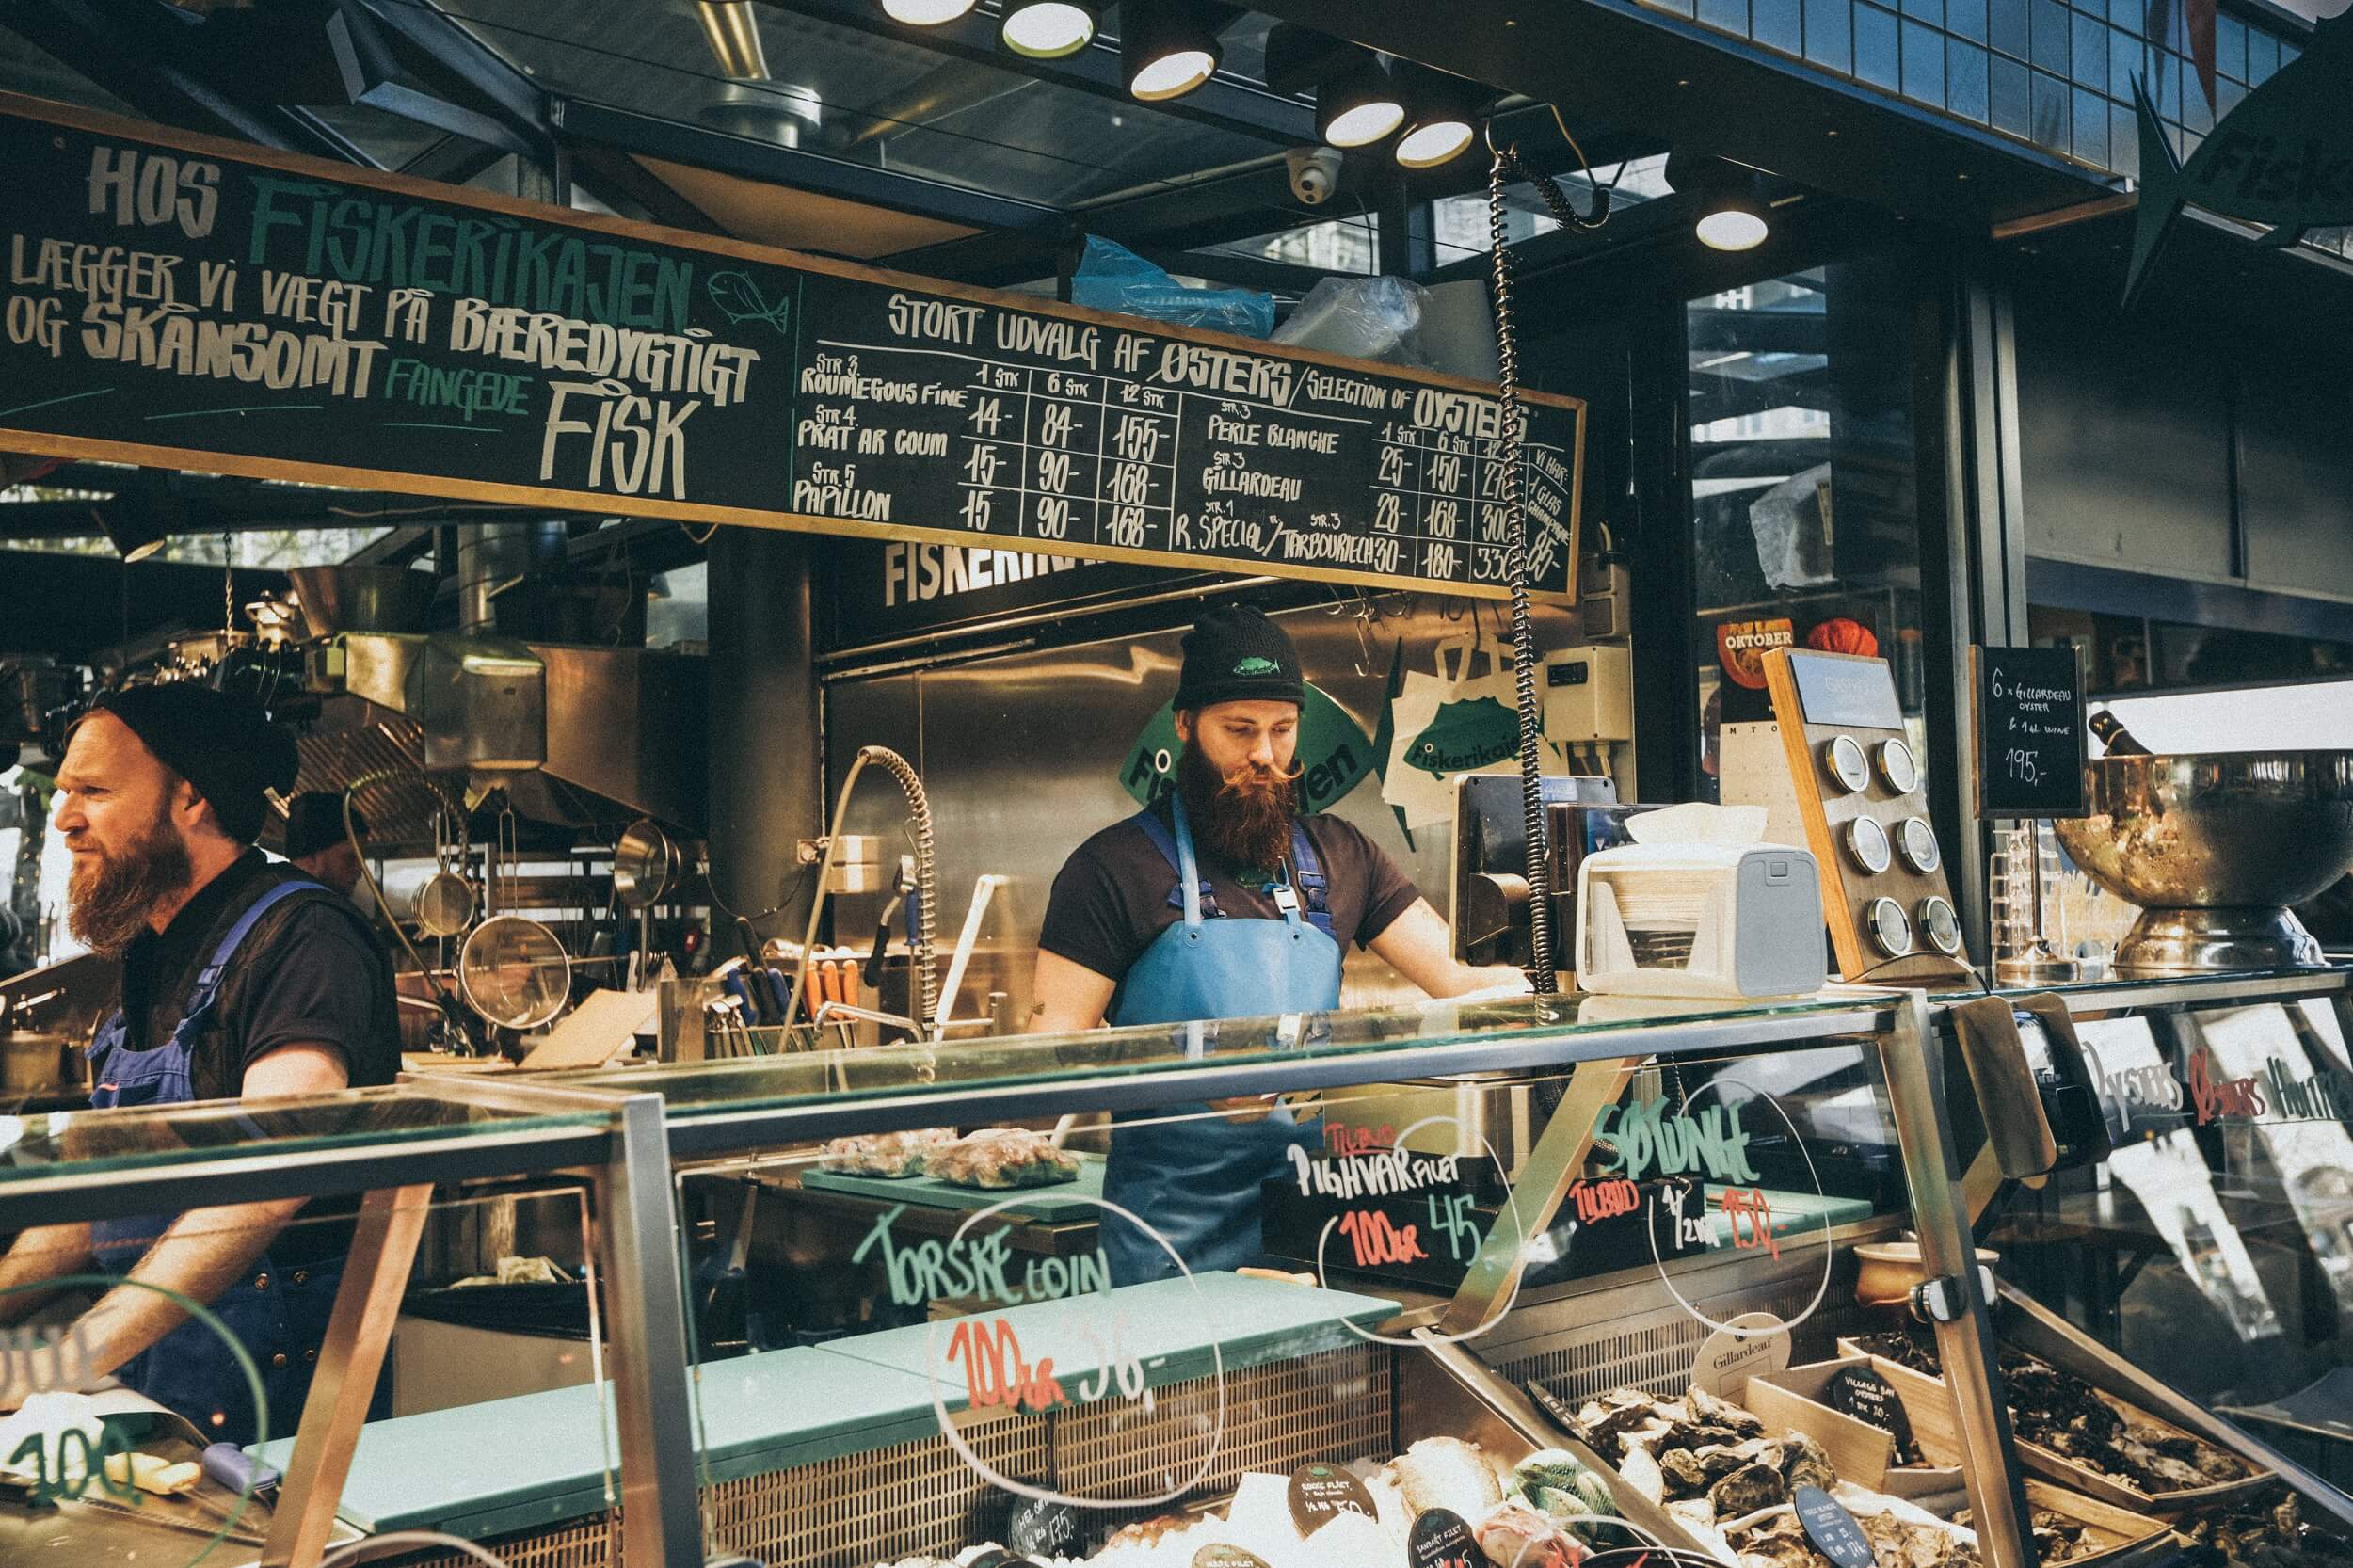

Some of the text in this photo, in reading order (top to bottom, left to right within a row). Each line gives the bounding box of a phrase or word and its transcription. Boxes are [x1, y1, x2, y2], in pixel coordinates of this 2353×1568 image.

[86, 146, 220, 239] HOS
[11, 233, 184, 304] LÆGGER
[262, 270, 373, 340] VÆGT
[384, 288, 435, 344] PÅ
[889, 293, 984, 344] STORT
[998, 312, 1100, 370] UDVALG
[1114, 333, 1155, 373] AF
[1391, 386, 1414, 410] OF
[801, 367, 917, 405] ROUMEGOUS
[976, 364, 1019, 387] 1 STK
[1048, 372, 1088, 397] 6 STK
[7, 296, 701, 500] OG SKÅNSOMT FANGEDE FISK
[1120, 384, 1165, 408] 12 STK
[798, 419, 855, 450] PRAT
[858, 428, 888, 455] AR
[1208, 414, 1262, 446] PERLE
[1381, 422, 1417, 445] 1 STK
[1438, 431, 1470, 455] 6 STK
[1483, 441, 1504, 459] 12
[845, 464, 856, 488] 5
[1529, 476, 1541, 494] 1
[793, 479, 891, 521] PAPILLON
[1725, 632, 1793, 649] OKTOBER
[1992, 667, 2003, 698] 6
[2019, 702, 2049, 712] OYSTER
[2045, 726, 2071, 735] WINE
[852, 1204, 1023, 1305] TORSKE
[1713, 1338, 1772, 1369] Gillardeau
